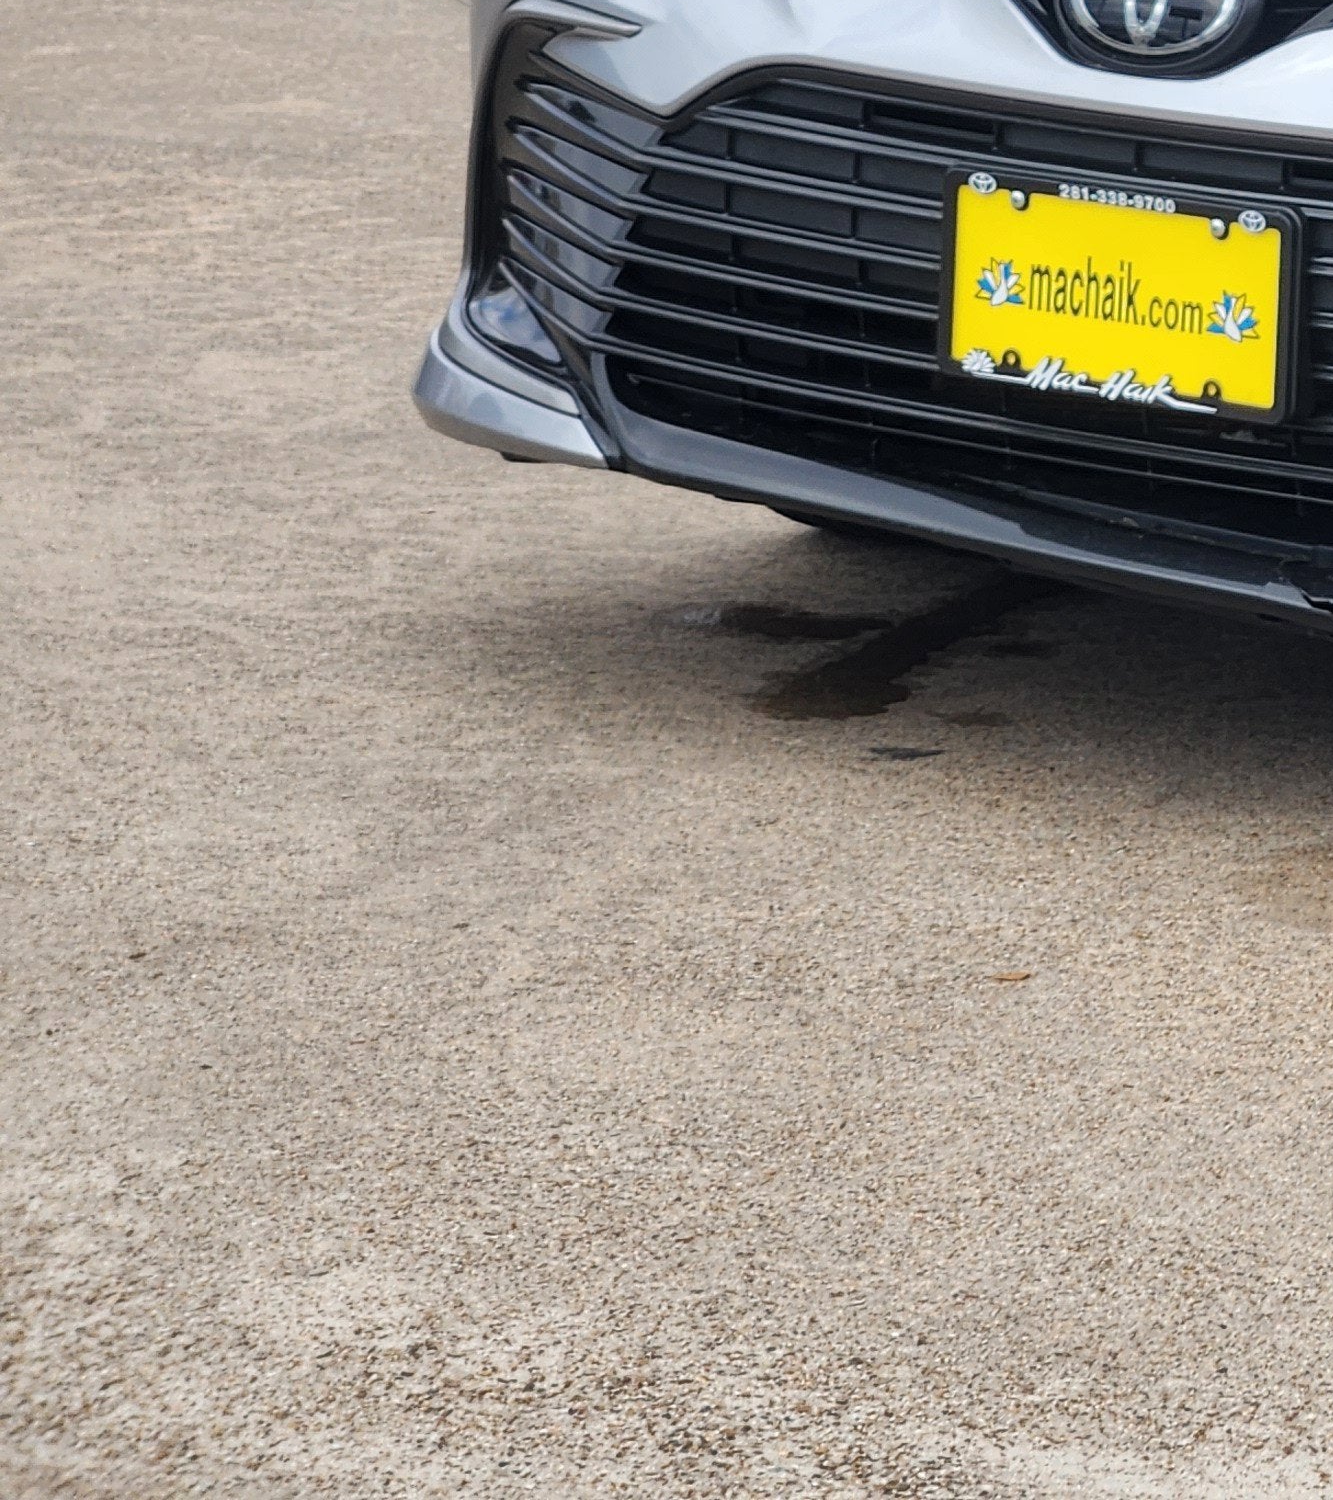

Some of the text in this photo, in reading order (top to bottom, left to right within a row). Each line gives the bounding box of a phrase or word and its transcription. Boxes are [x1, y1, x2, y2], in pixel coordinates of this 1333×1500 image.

[1028, 256, 1204, 335] machaik.com
[1026, 357, 1180, 404] Mac Haik
